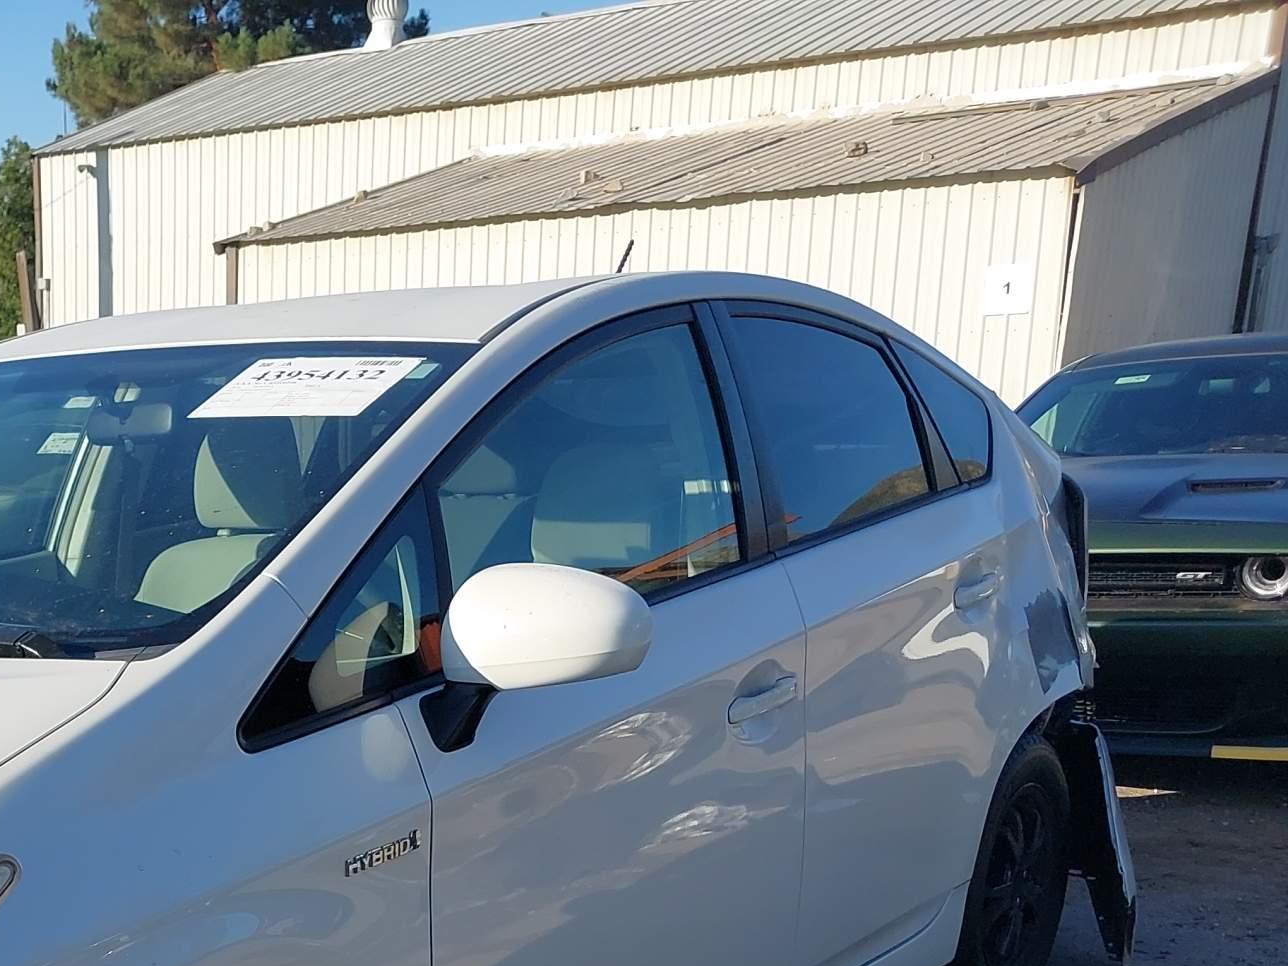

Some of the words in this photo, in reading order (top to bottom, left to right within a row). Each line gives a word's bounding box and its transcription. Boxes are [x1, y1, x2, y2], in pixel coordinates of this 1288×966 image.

[1002, 281, 1011, 295] 1
[252, 369, 386, 382] 43954132
[1176, 571, 1213, 579] GT
[344, 836, 411, 877] HYBRID
